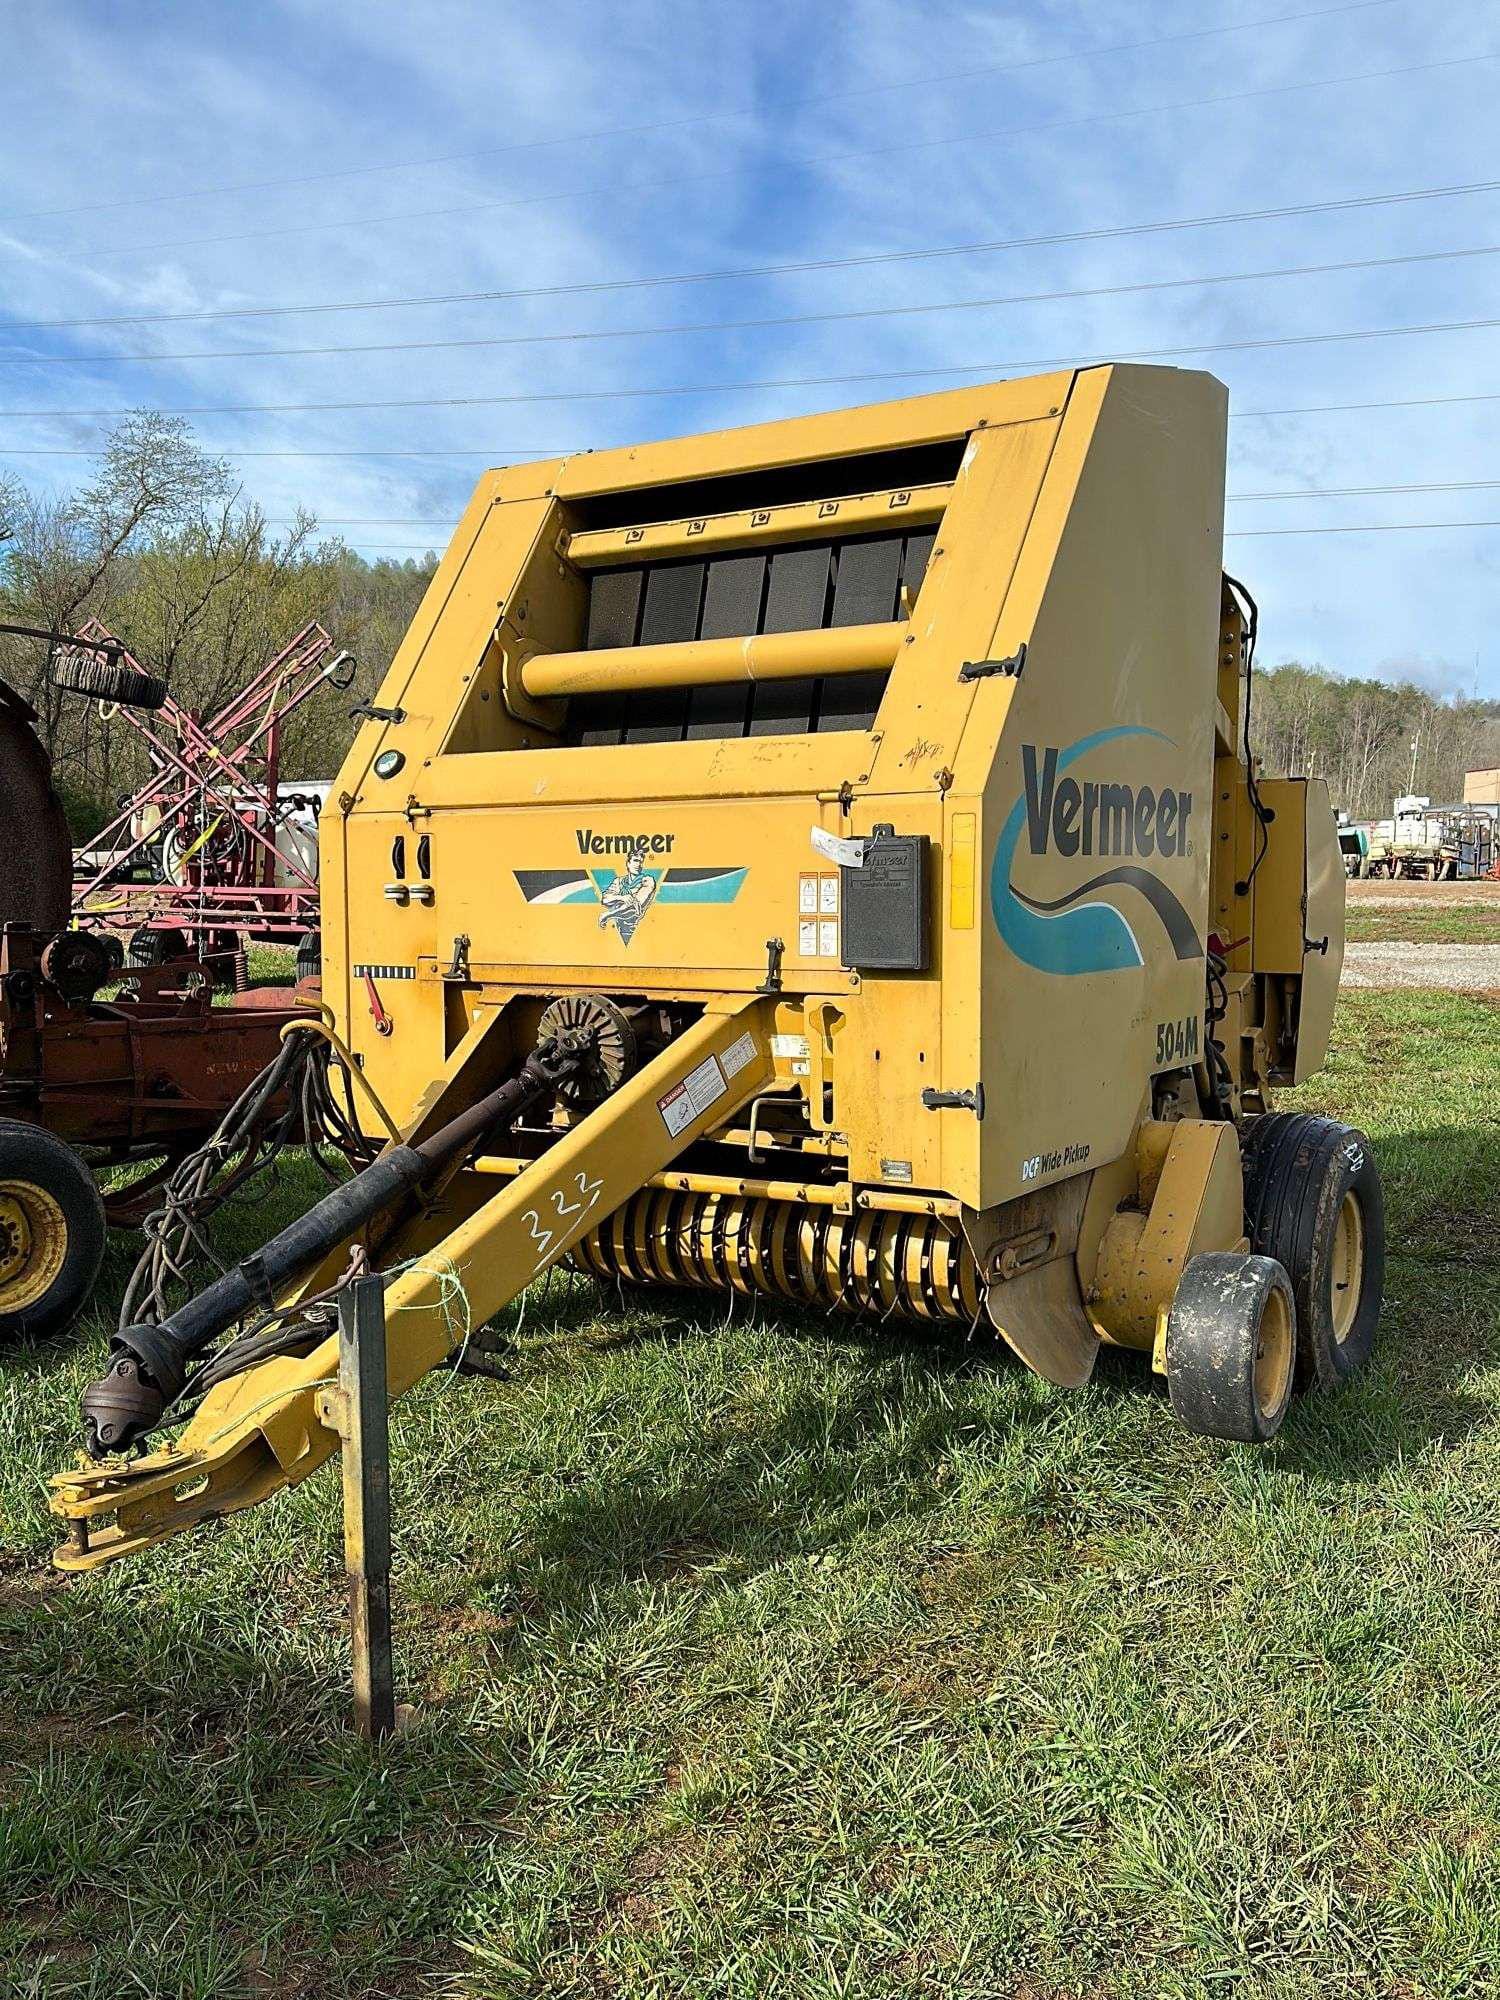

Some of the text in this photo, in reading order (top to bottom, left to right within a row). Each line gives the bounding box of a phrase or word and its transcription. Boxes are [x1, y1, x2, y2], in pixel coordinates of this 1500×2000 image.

[1022, 744, 1192, 857] Vermeer
[576, 829, 675, 855] Vermeer
[863, 854, 909, 867] ermeer
[1156, 1015, 1199, 1065] 504M
[1022, 1143, 1091, 1182] DCF Wide Pickup
[521, 1172, 604, 1253] 322
